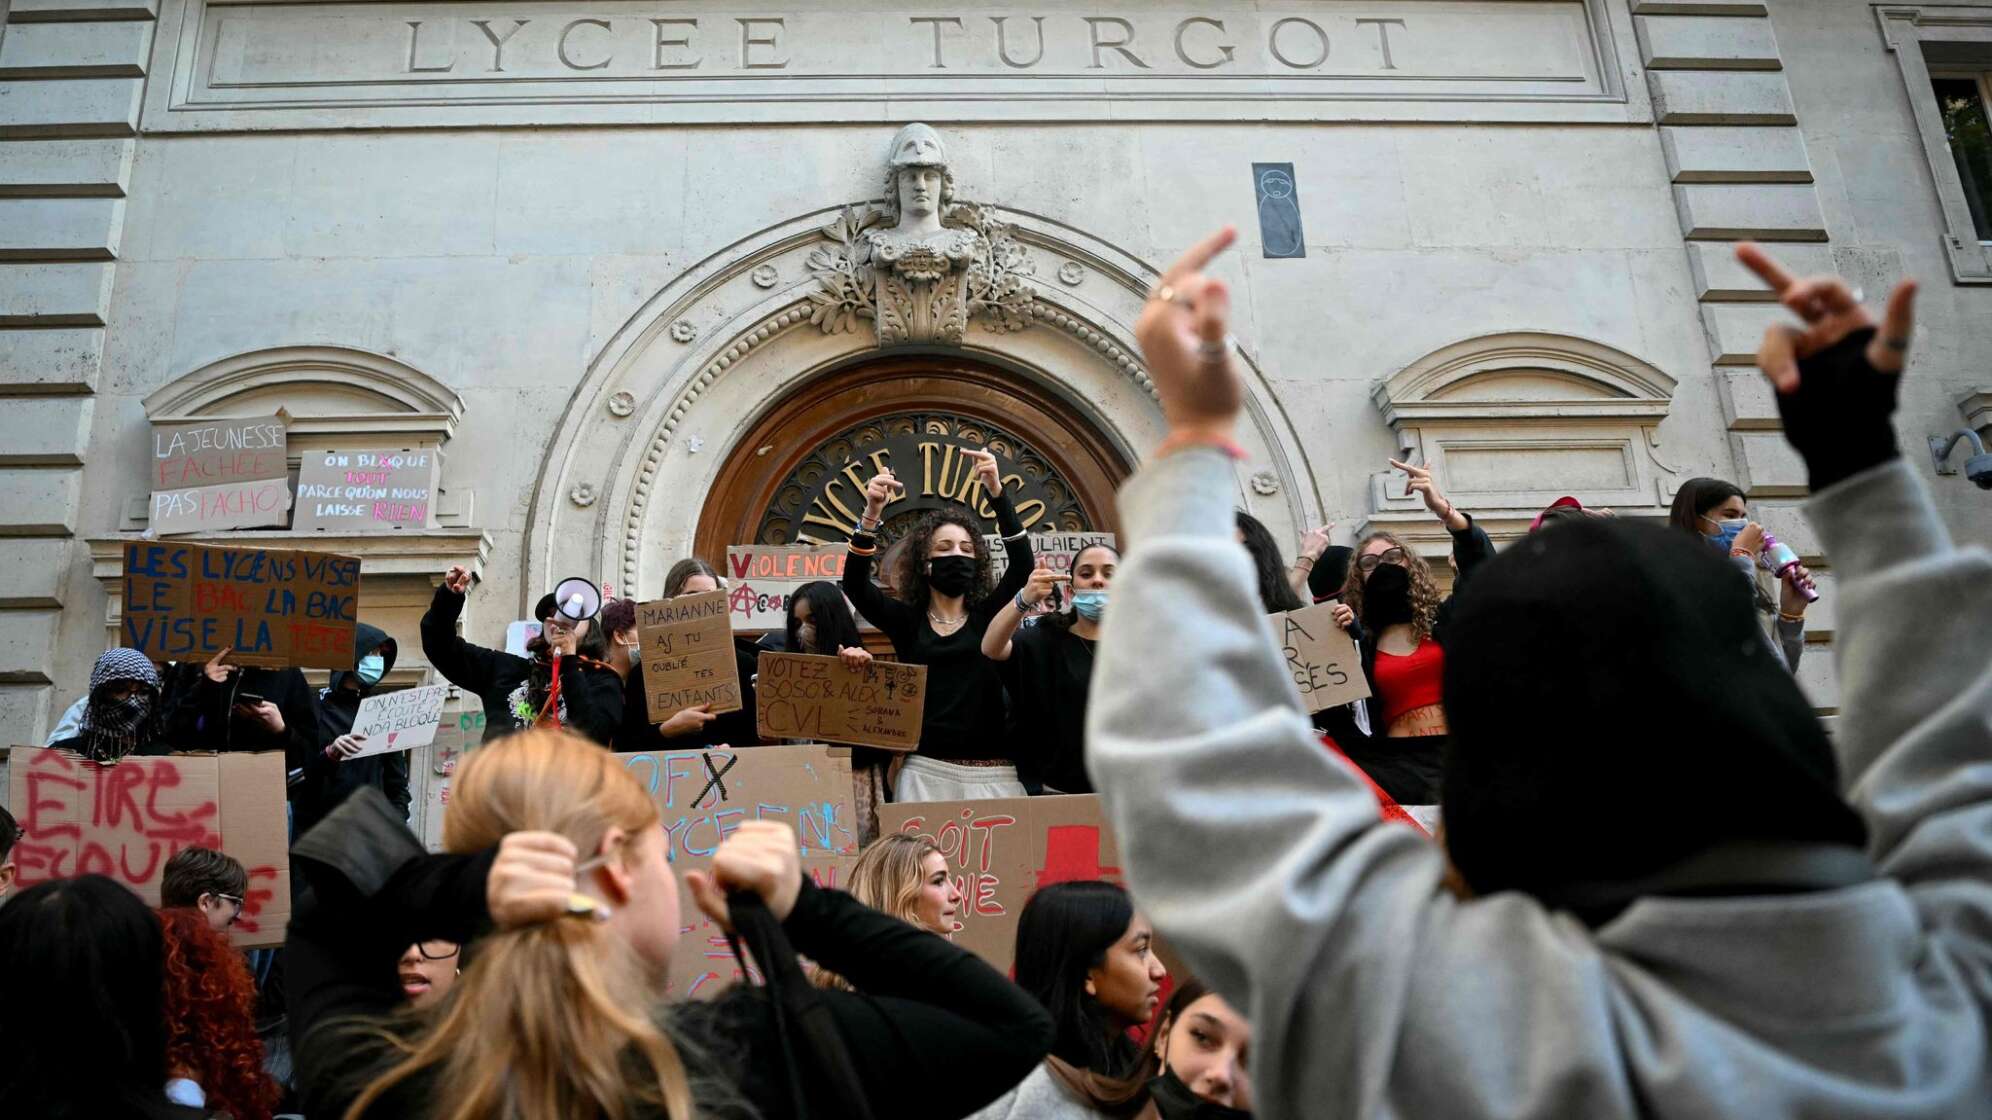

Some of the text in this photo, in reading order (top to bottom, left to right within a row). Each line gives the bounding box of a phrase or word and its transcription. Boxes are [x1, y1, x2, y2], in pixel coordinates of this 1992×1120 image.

[403, 16, 1407, 74] LYCEE TURGOT
[156, 424, 284, 458] LA JEUNESSE
[324, 455, 348, 467] ON
[345, 470, 388, 485] TOUT
[298, 484, 342, 498] PARCE
[391, 488, 428, 500] NOUS
[155, 489, 199, 520] PAS
[316, 501, 427, 522] LAISSE RIEN
[127, 545, 188, 578] LES
[127, 578, 357, 621] LE BAC LA BAC
[644, 600, 725, 625] MARIANNE
[234, 617, 273, 653] LA
[685, 632, 701, 646] TU
[694, 669, 714, 678] TES
[764, 657, 829, 680] VOTEZ
[762, 679, 819, 699] SOSO
[839, 682, 881, 703] ALEX
[765, 700, 841, 737] CVL
